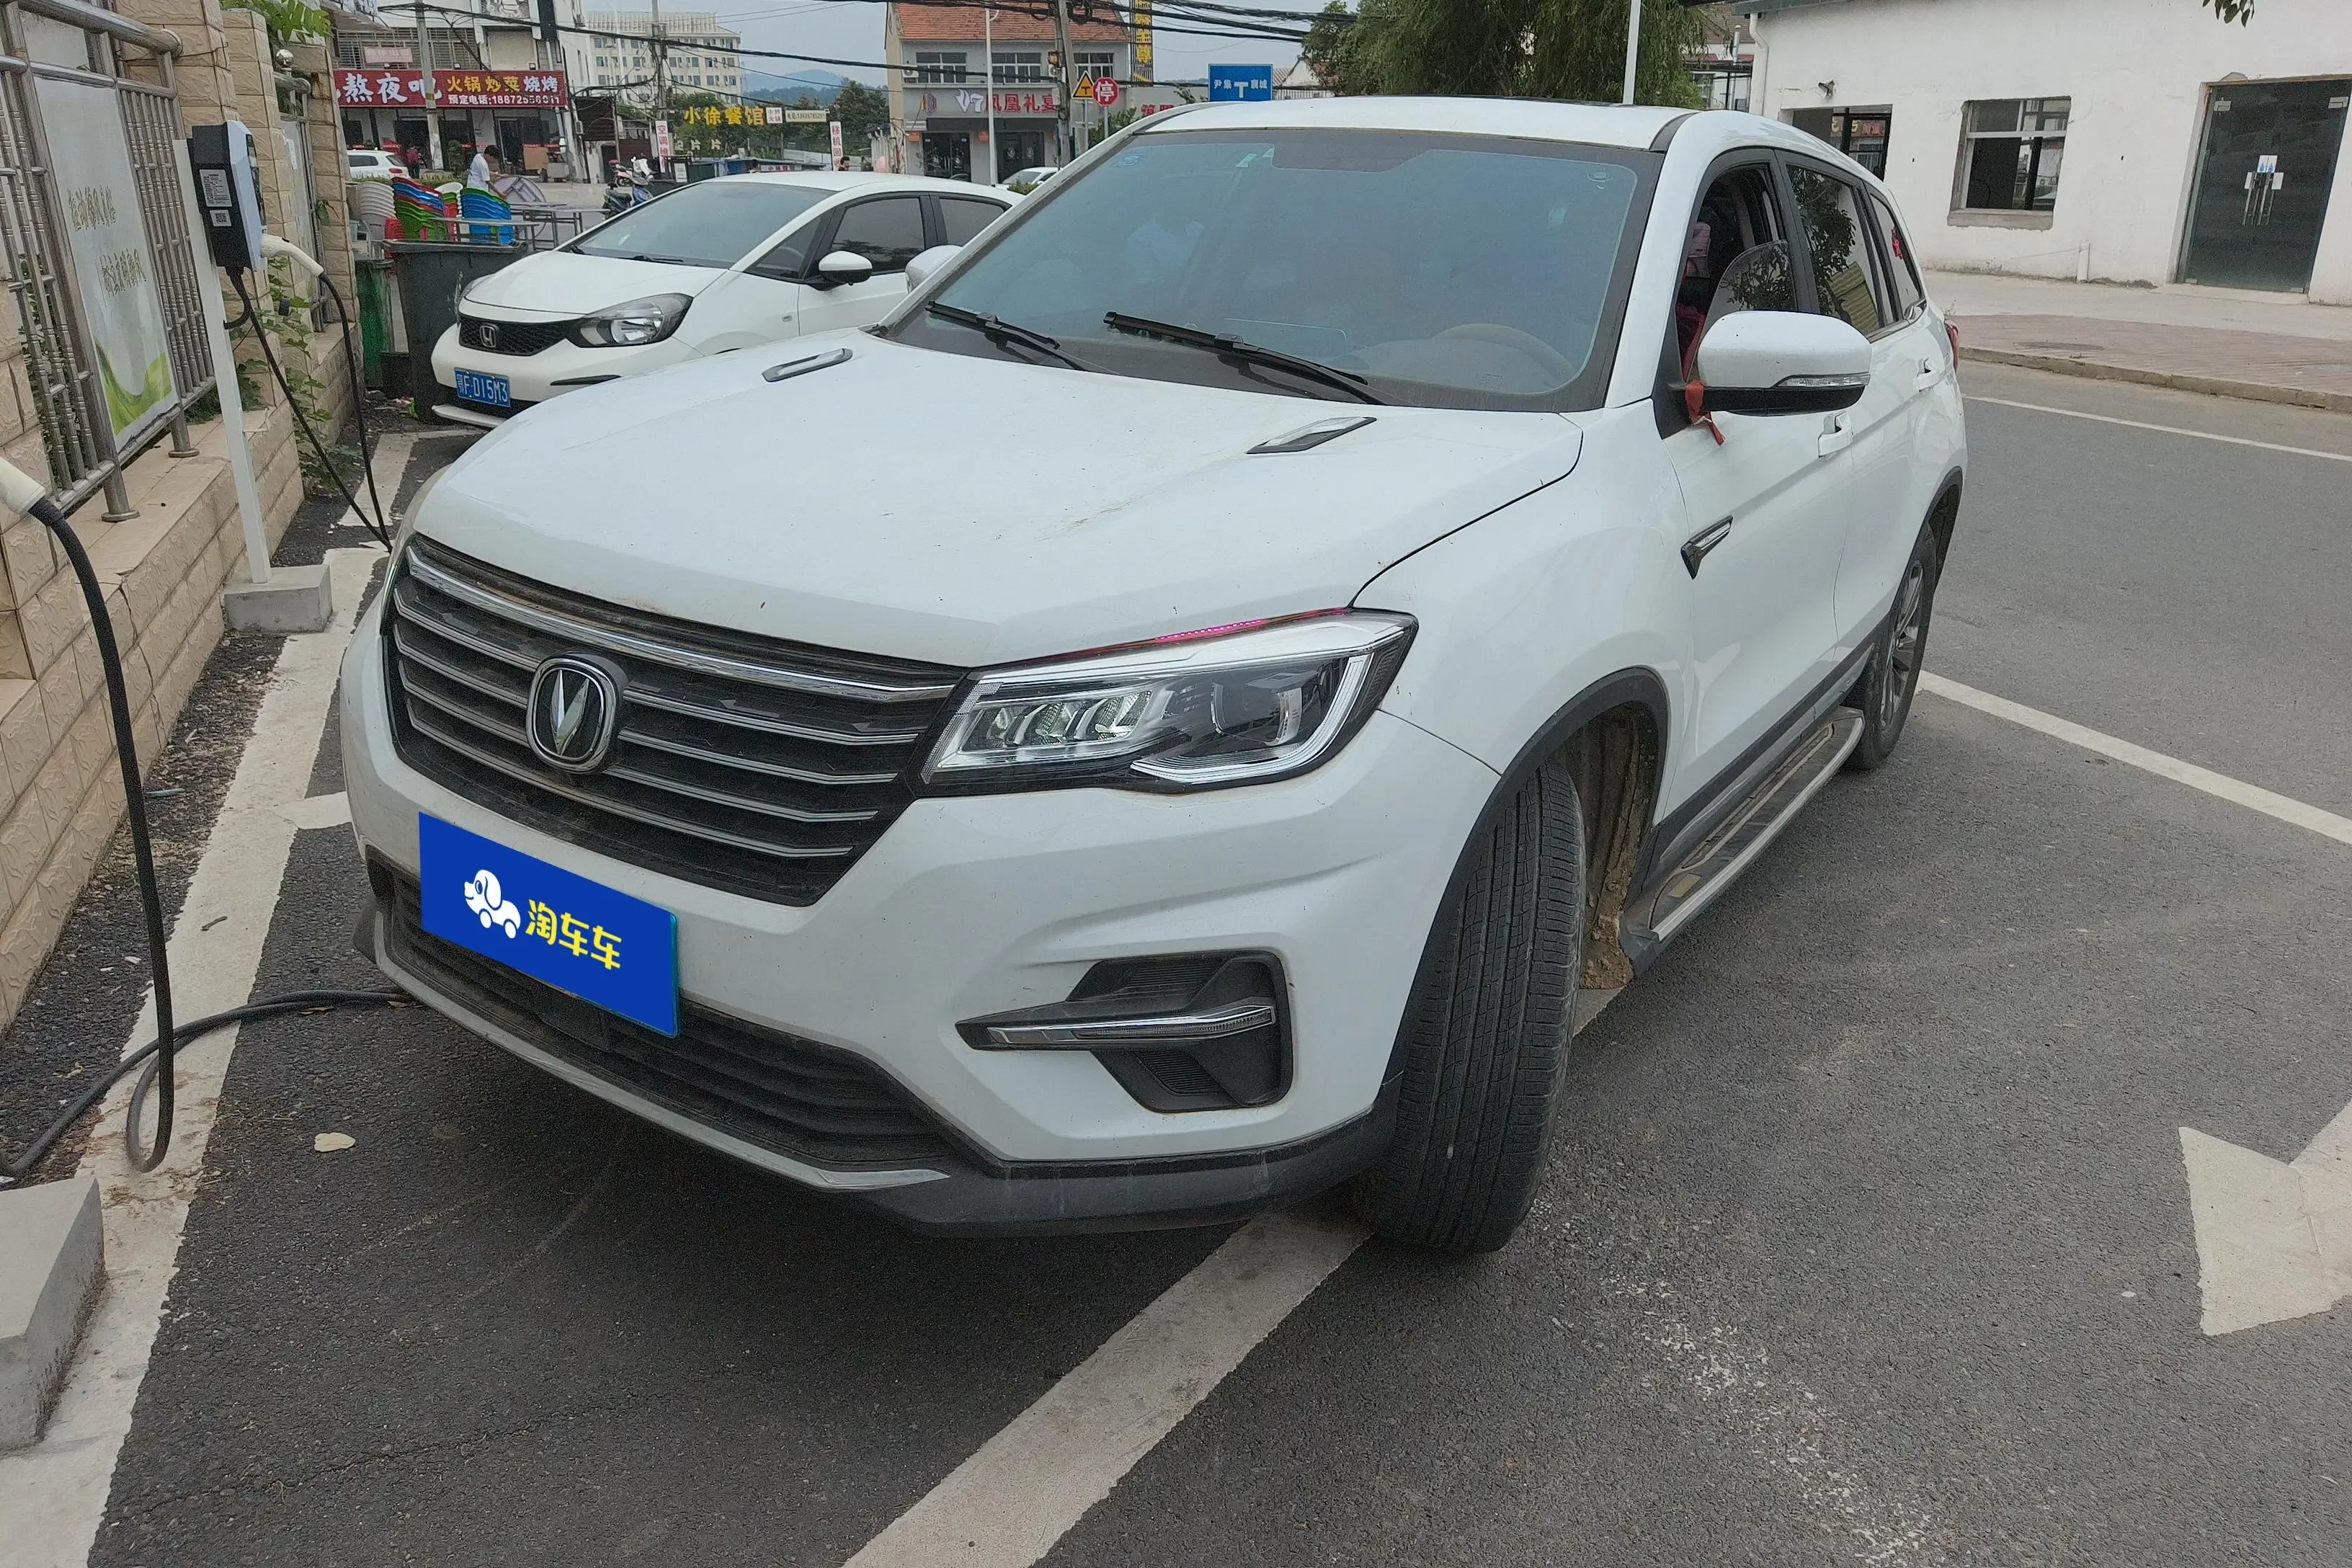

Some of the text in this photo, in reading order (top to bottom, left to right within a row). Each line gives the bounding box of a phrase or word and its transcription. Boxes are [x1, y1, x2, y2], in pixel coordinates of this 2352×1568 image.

[337, 73, 442, 104] 熬夜吧
[447, 76, 558, 93] 火锅 炒菜 烧烤
[1095, 81, 1115, 102] 停
[683, 105, 765, 126] 小徐餐馆
